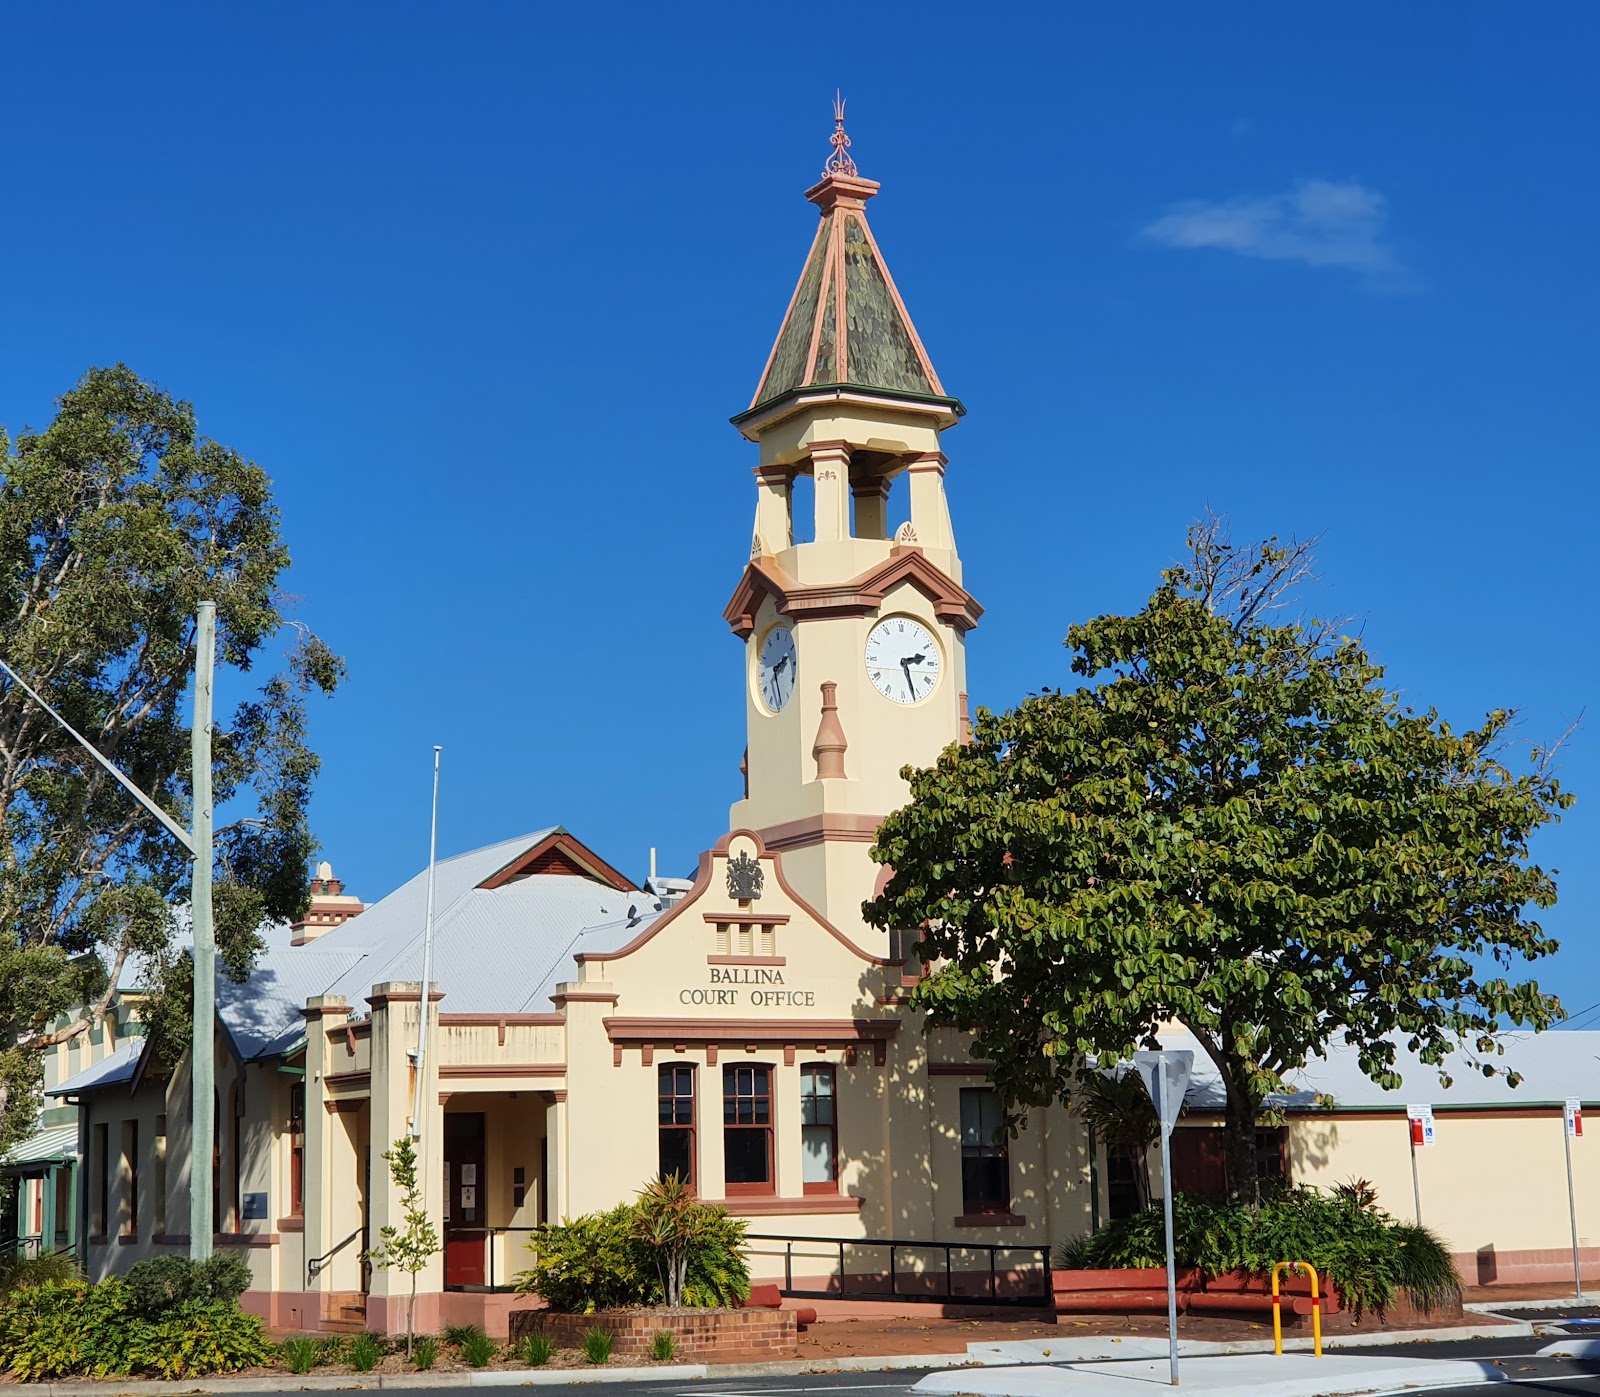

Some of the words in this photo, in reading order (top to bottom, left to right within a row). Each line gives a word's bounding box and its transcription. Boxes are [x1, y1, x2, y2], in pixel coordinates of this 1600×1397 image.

[709, 968, 785, 985] BALLINA
[679, 989, 739, 1005] COURT
[751, 990, 816, 1007] OFFICE
